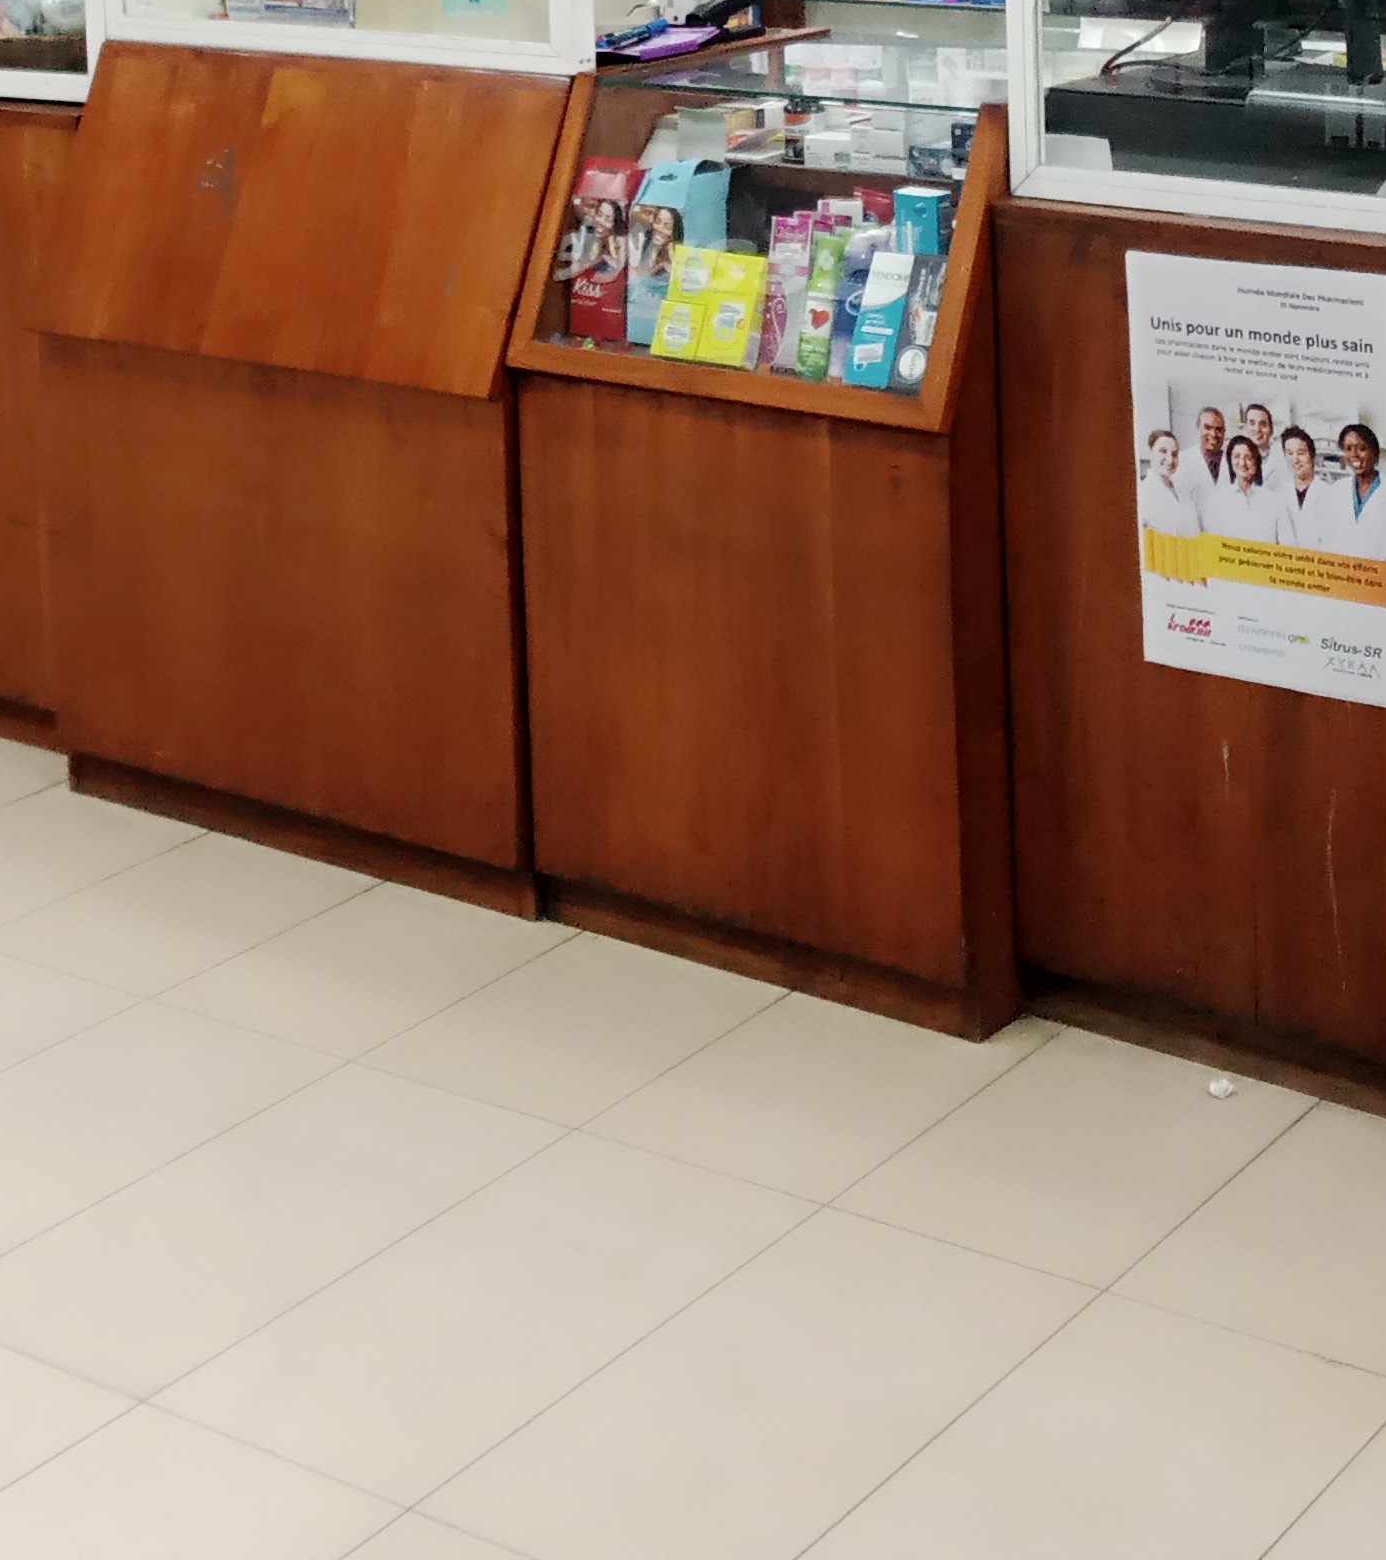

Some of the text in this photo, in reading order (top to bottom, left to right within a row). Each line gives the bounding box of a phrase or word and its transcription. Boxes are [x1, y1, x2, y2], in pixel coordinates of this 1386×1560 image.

[573, 278, 602, 299] Kiss
[1150, 316, 1374, 354] Unis pour un monde plus sain
